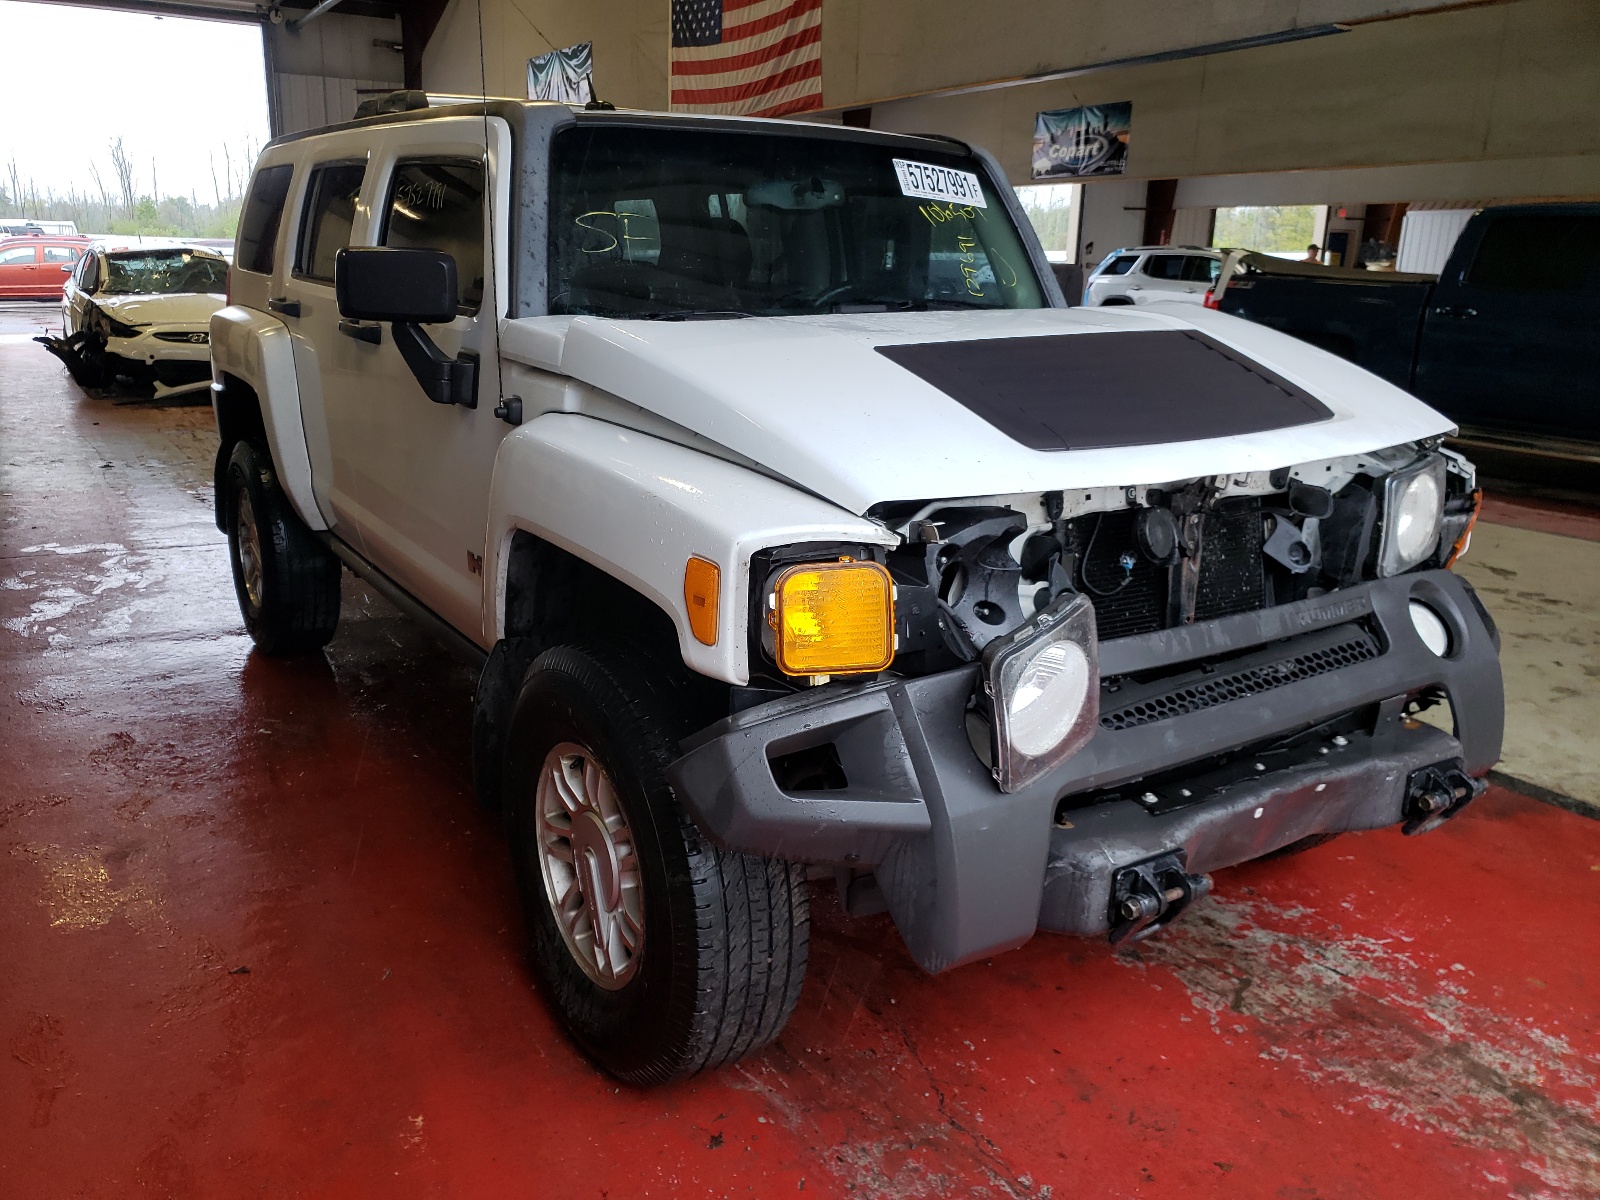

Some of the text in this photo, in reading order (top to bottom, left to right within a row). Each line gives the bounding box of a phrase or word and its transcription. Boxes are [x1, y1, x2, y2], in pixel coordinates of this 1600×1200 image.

[1048, 142, 1101, 162] Copart
[905, 163, 974, 199] 57527991
[971, 183, 979, 198] F
